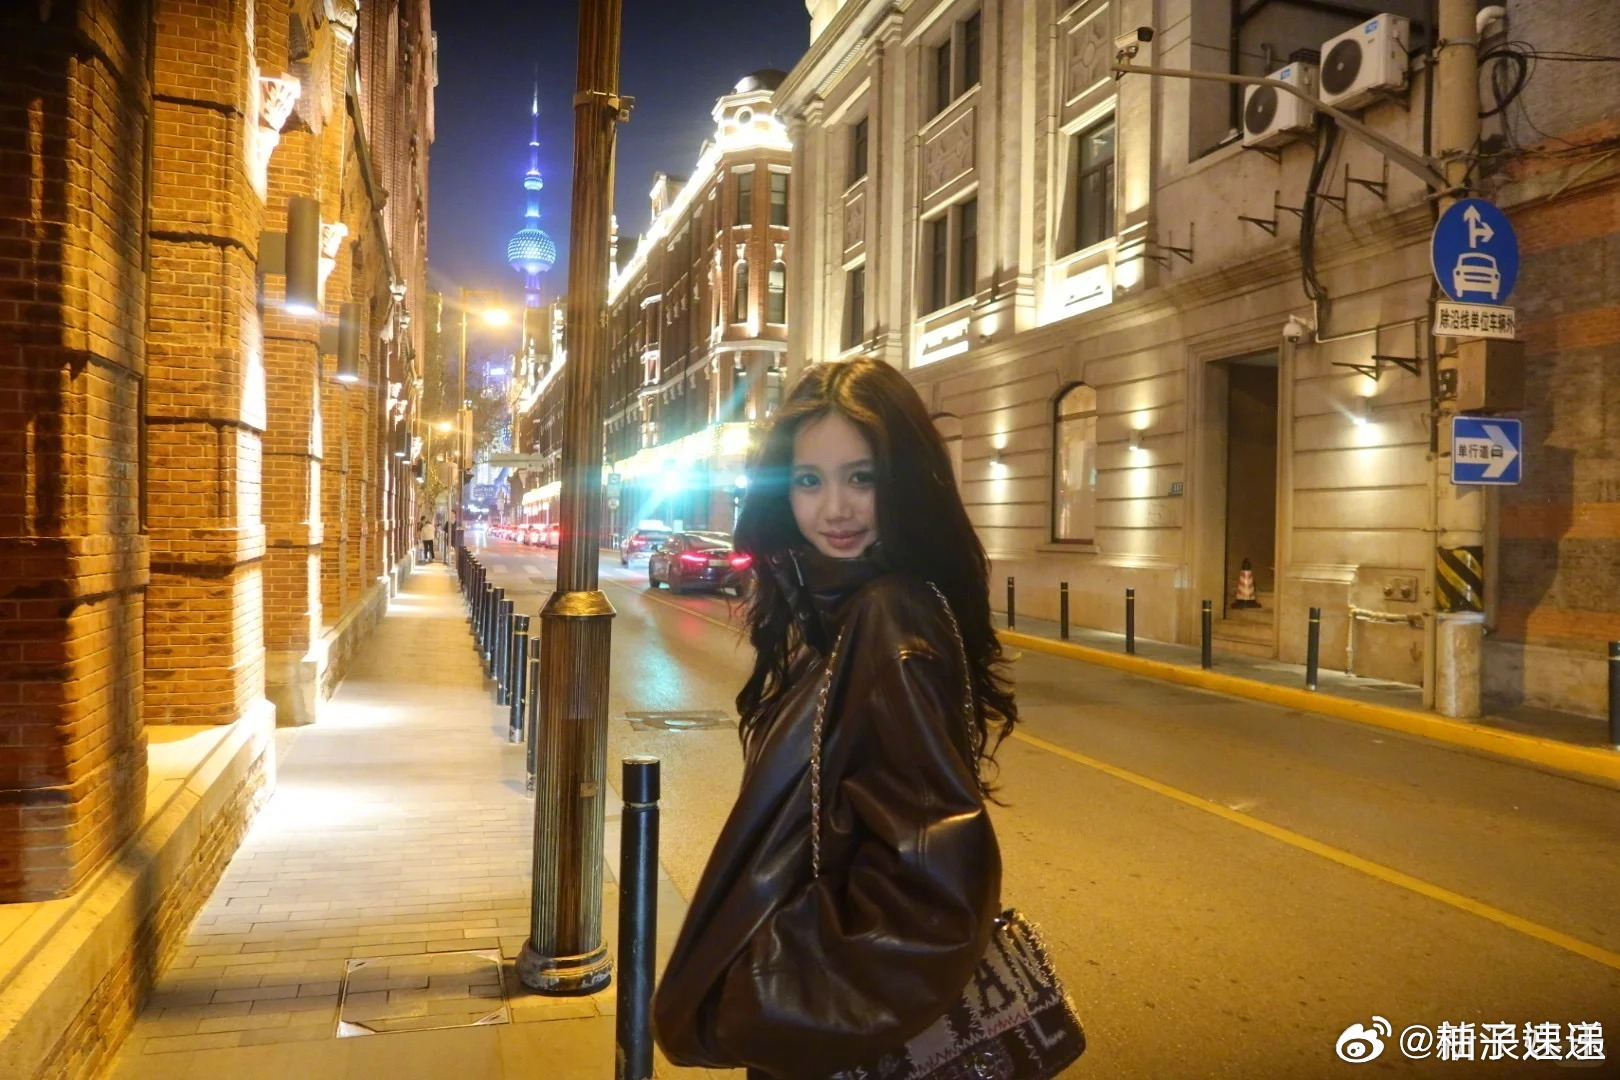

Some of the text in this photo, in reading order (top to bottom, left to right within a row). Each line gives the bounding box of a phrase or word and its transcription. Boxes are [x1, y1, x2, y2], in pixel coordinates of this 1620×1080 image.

[1440, 308, 1515, 334] 除沿线单位车辆外
[1457, 443, 1489, 459] 单行道
